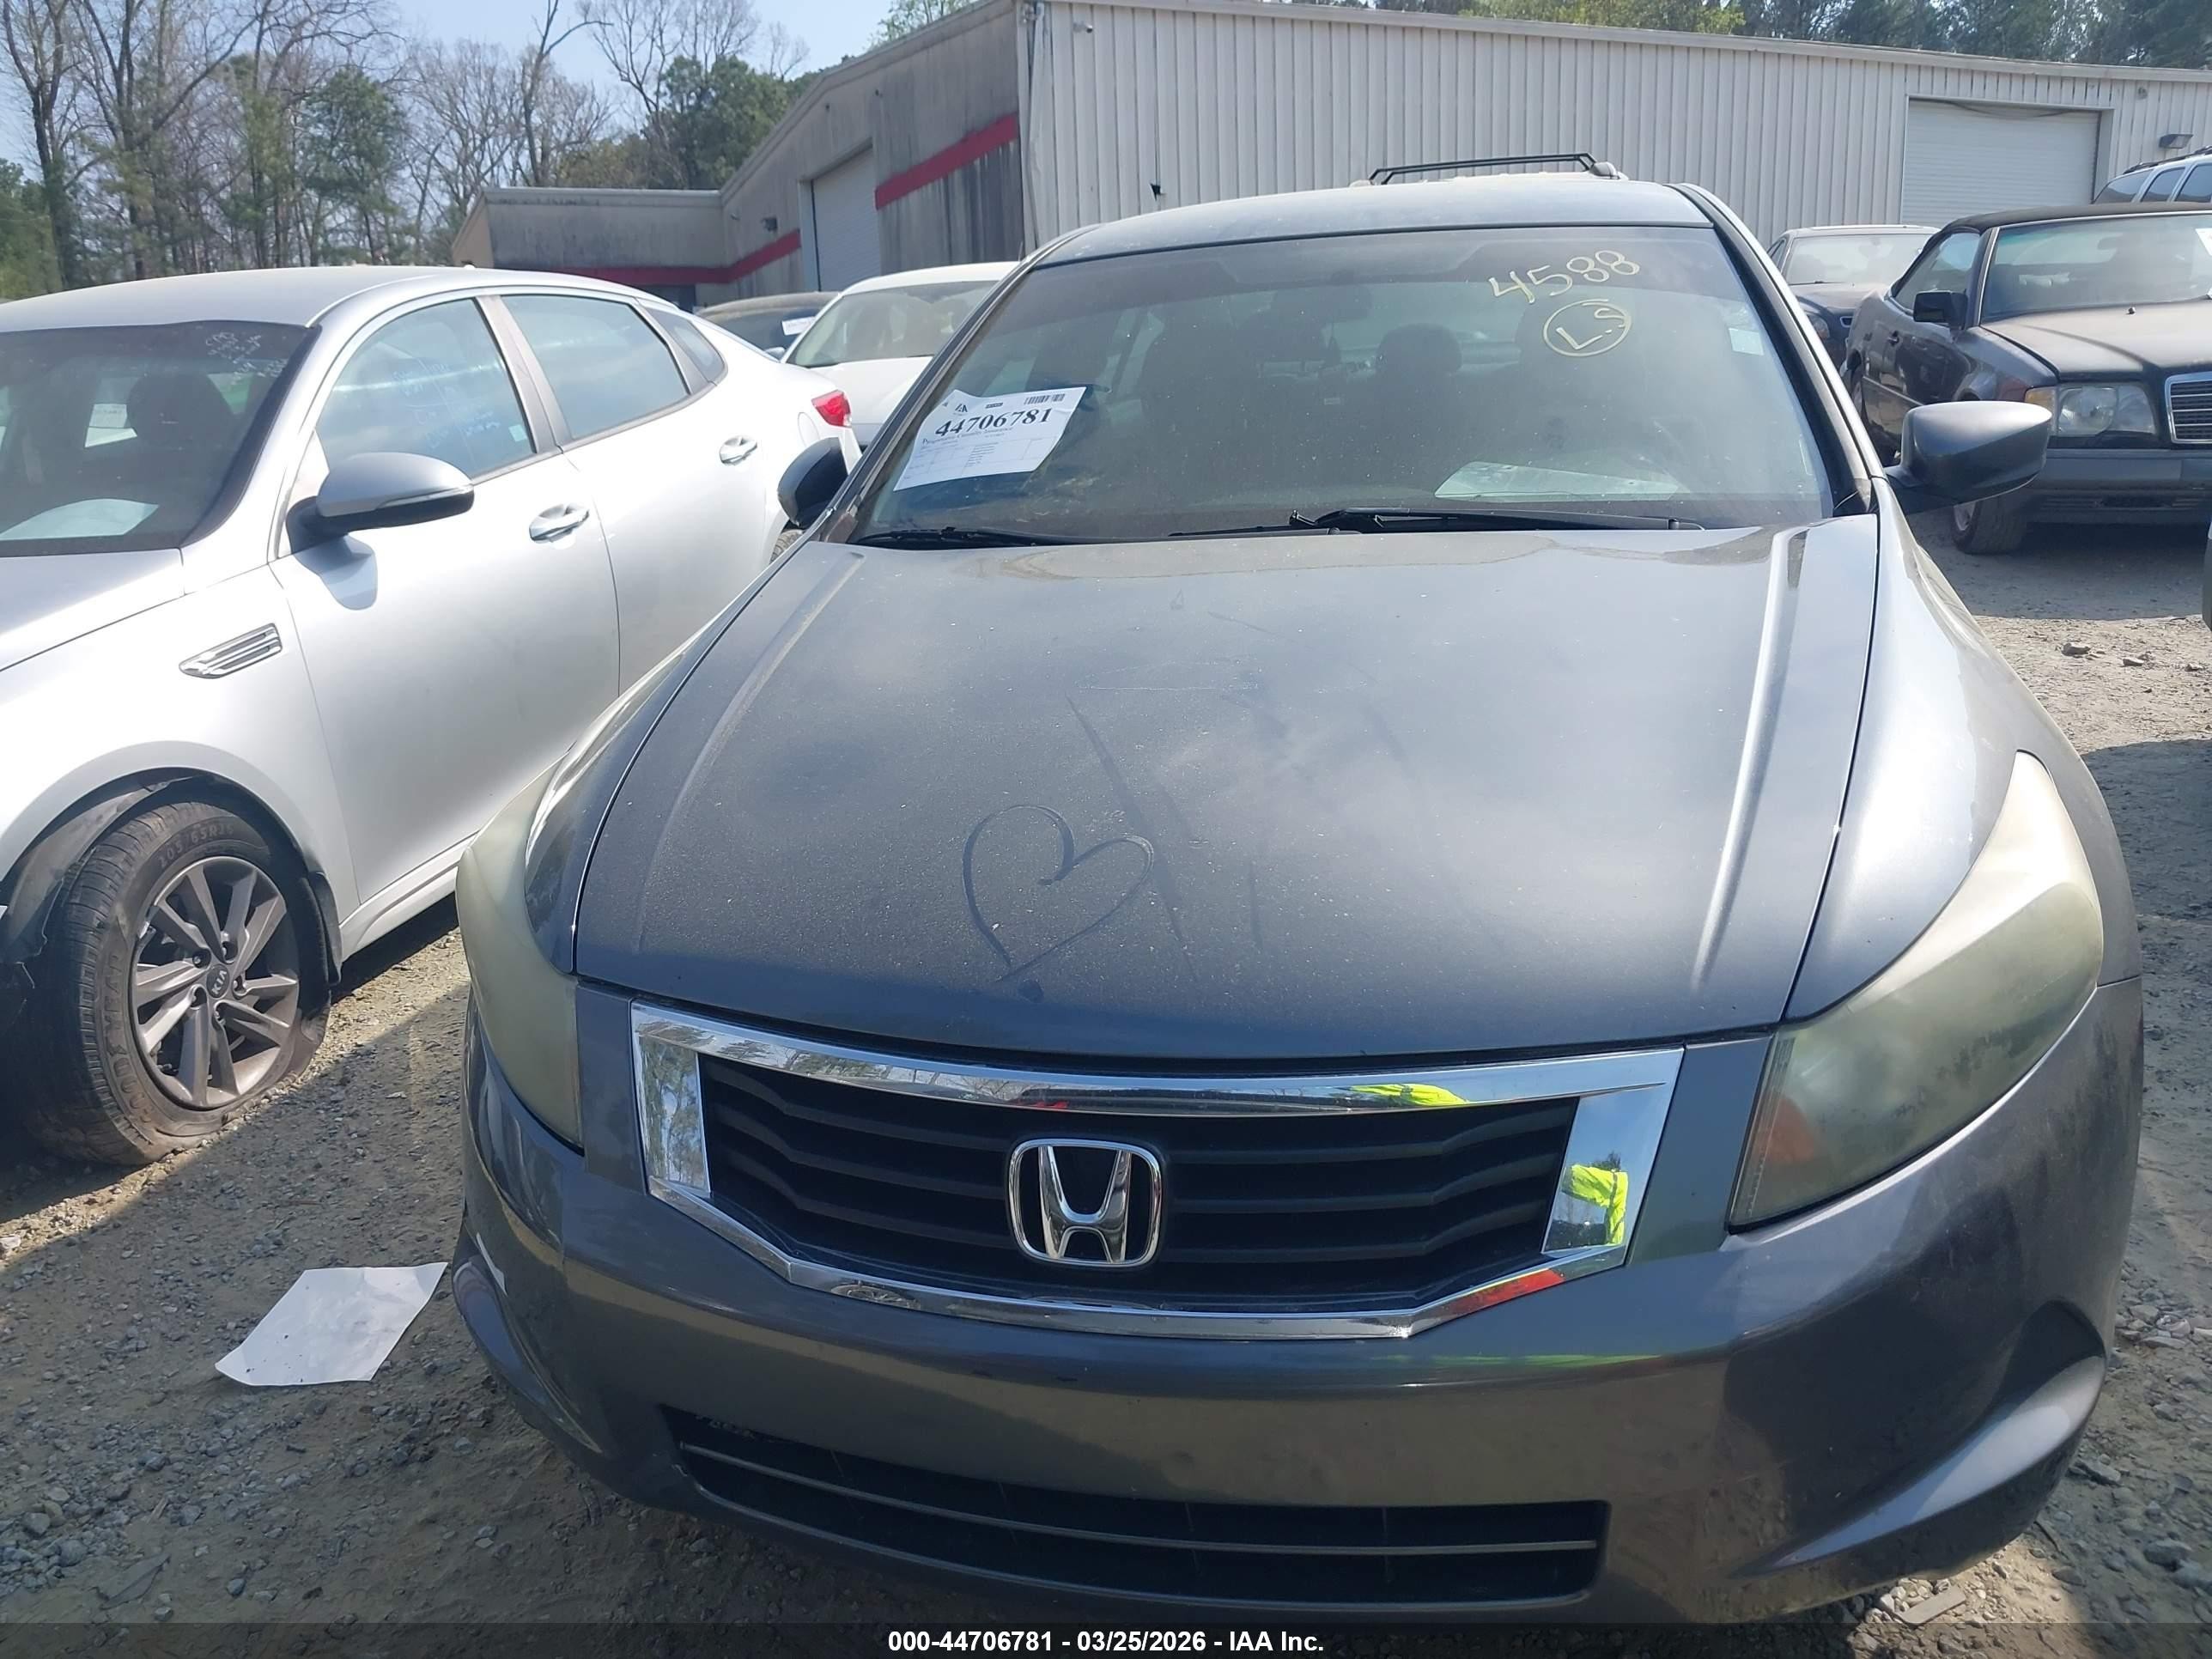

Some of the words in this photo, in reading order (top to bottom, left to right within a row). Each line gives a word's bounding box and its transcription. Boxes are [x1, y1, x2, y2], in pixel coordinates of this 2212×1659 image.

[1488, 250, 1640, 304] 4588
[934, 407, 1053, 436] 44706781
[211, 969, 228, 995] KIA
